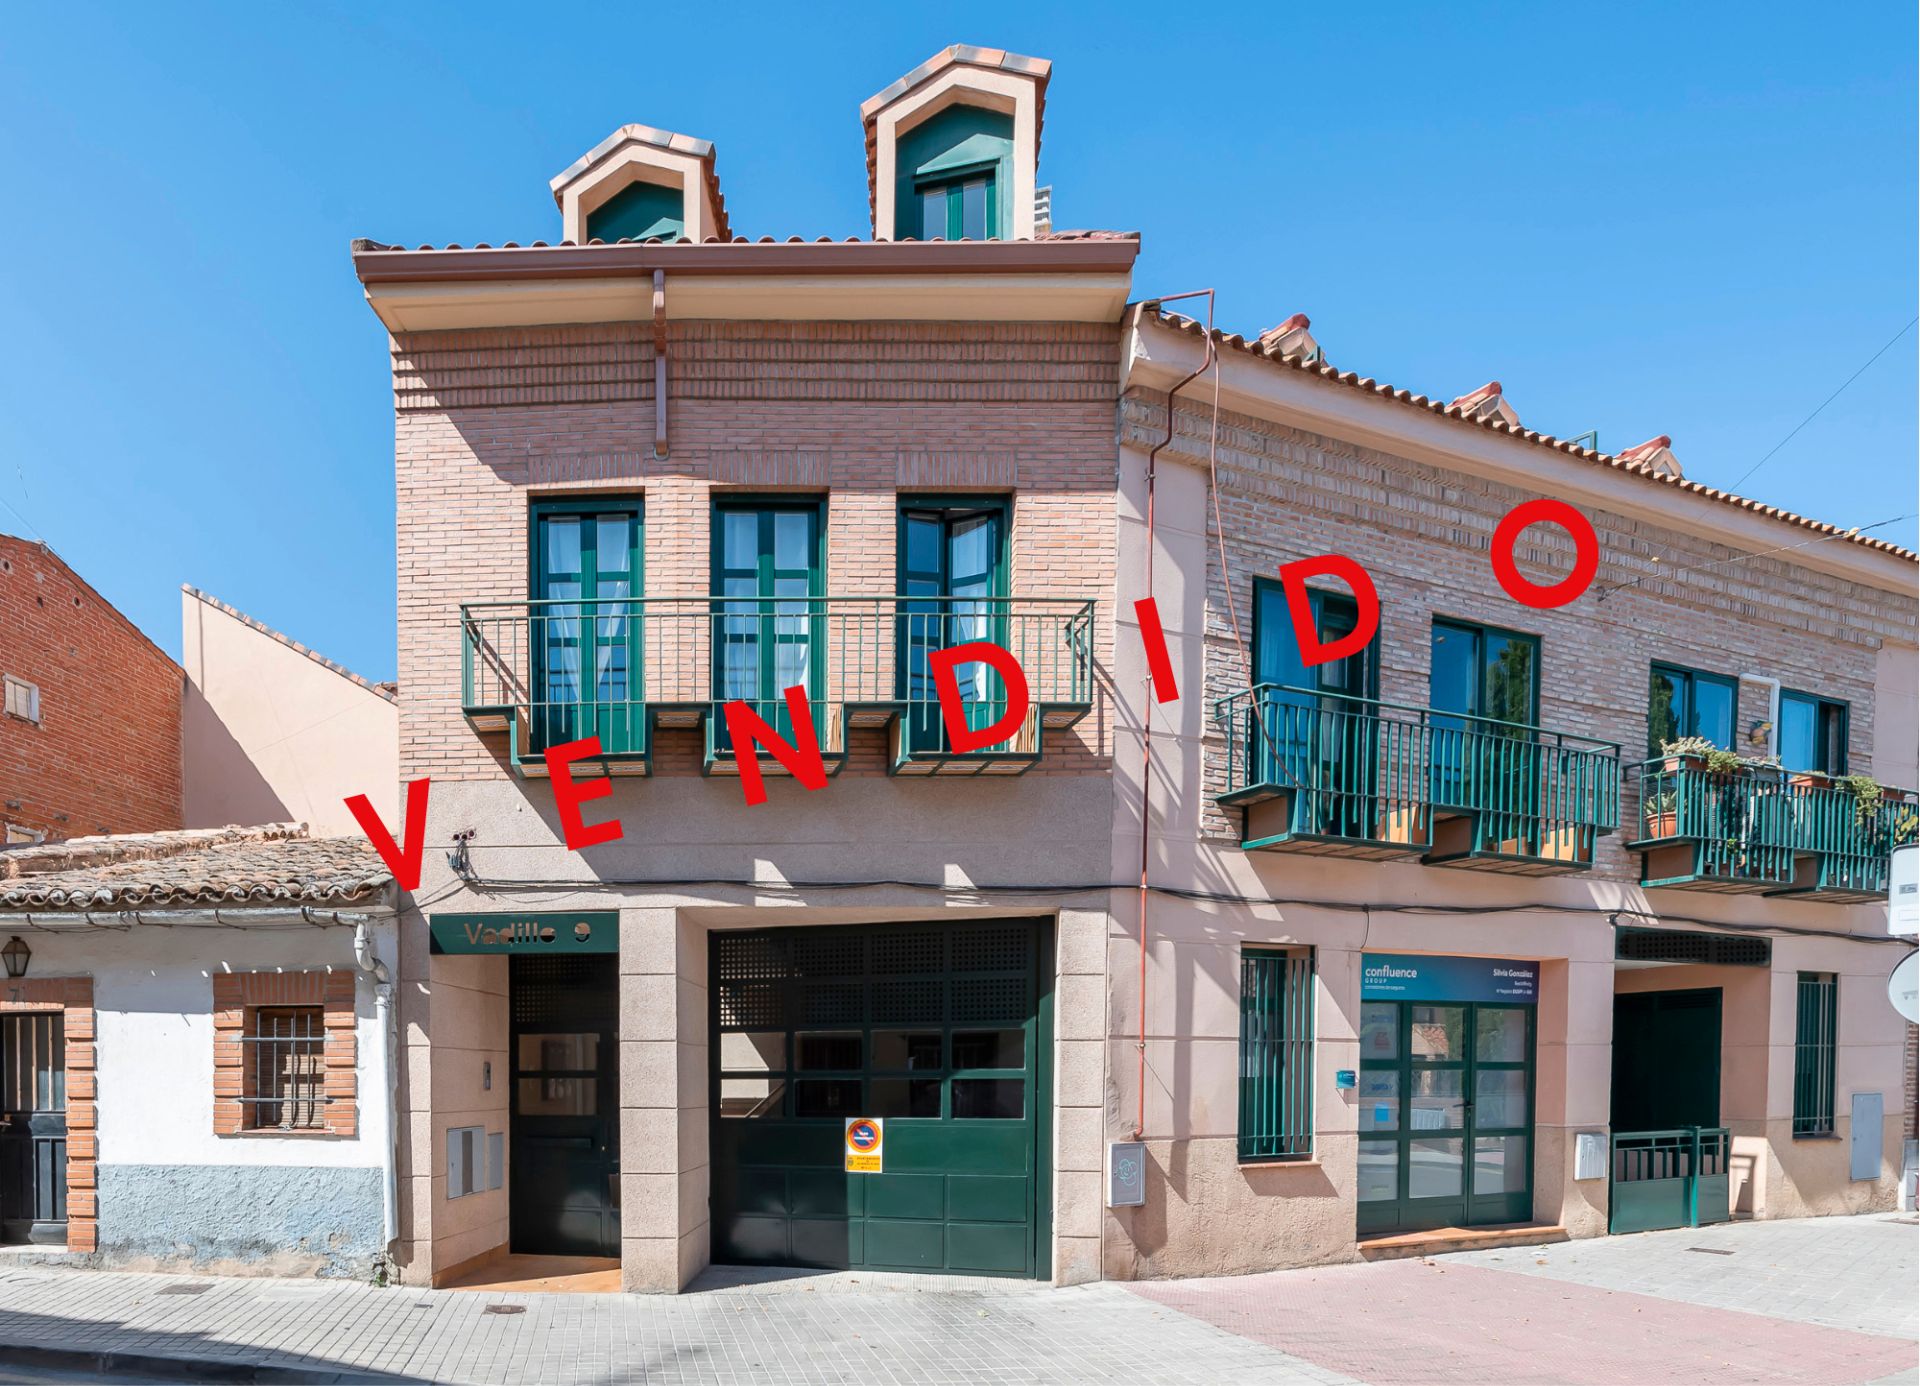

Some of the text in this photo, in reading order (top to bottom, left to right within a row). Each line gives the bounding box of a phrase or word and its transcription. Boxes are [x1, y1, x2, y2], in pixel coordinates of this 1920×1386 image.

[464, 922, 591, 944] Vadillo 9
[1365, 964, 1417, 978] confluence
